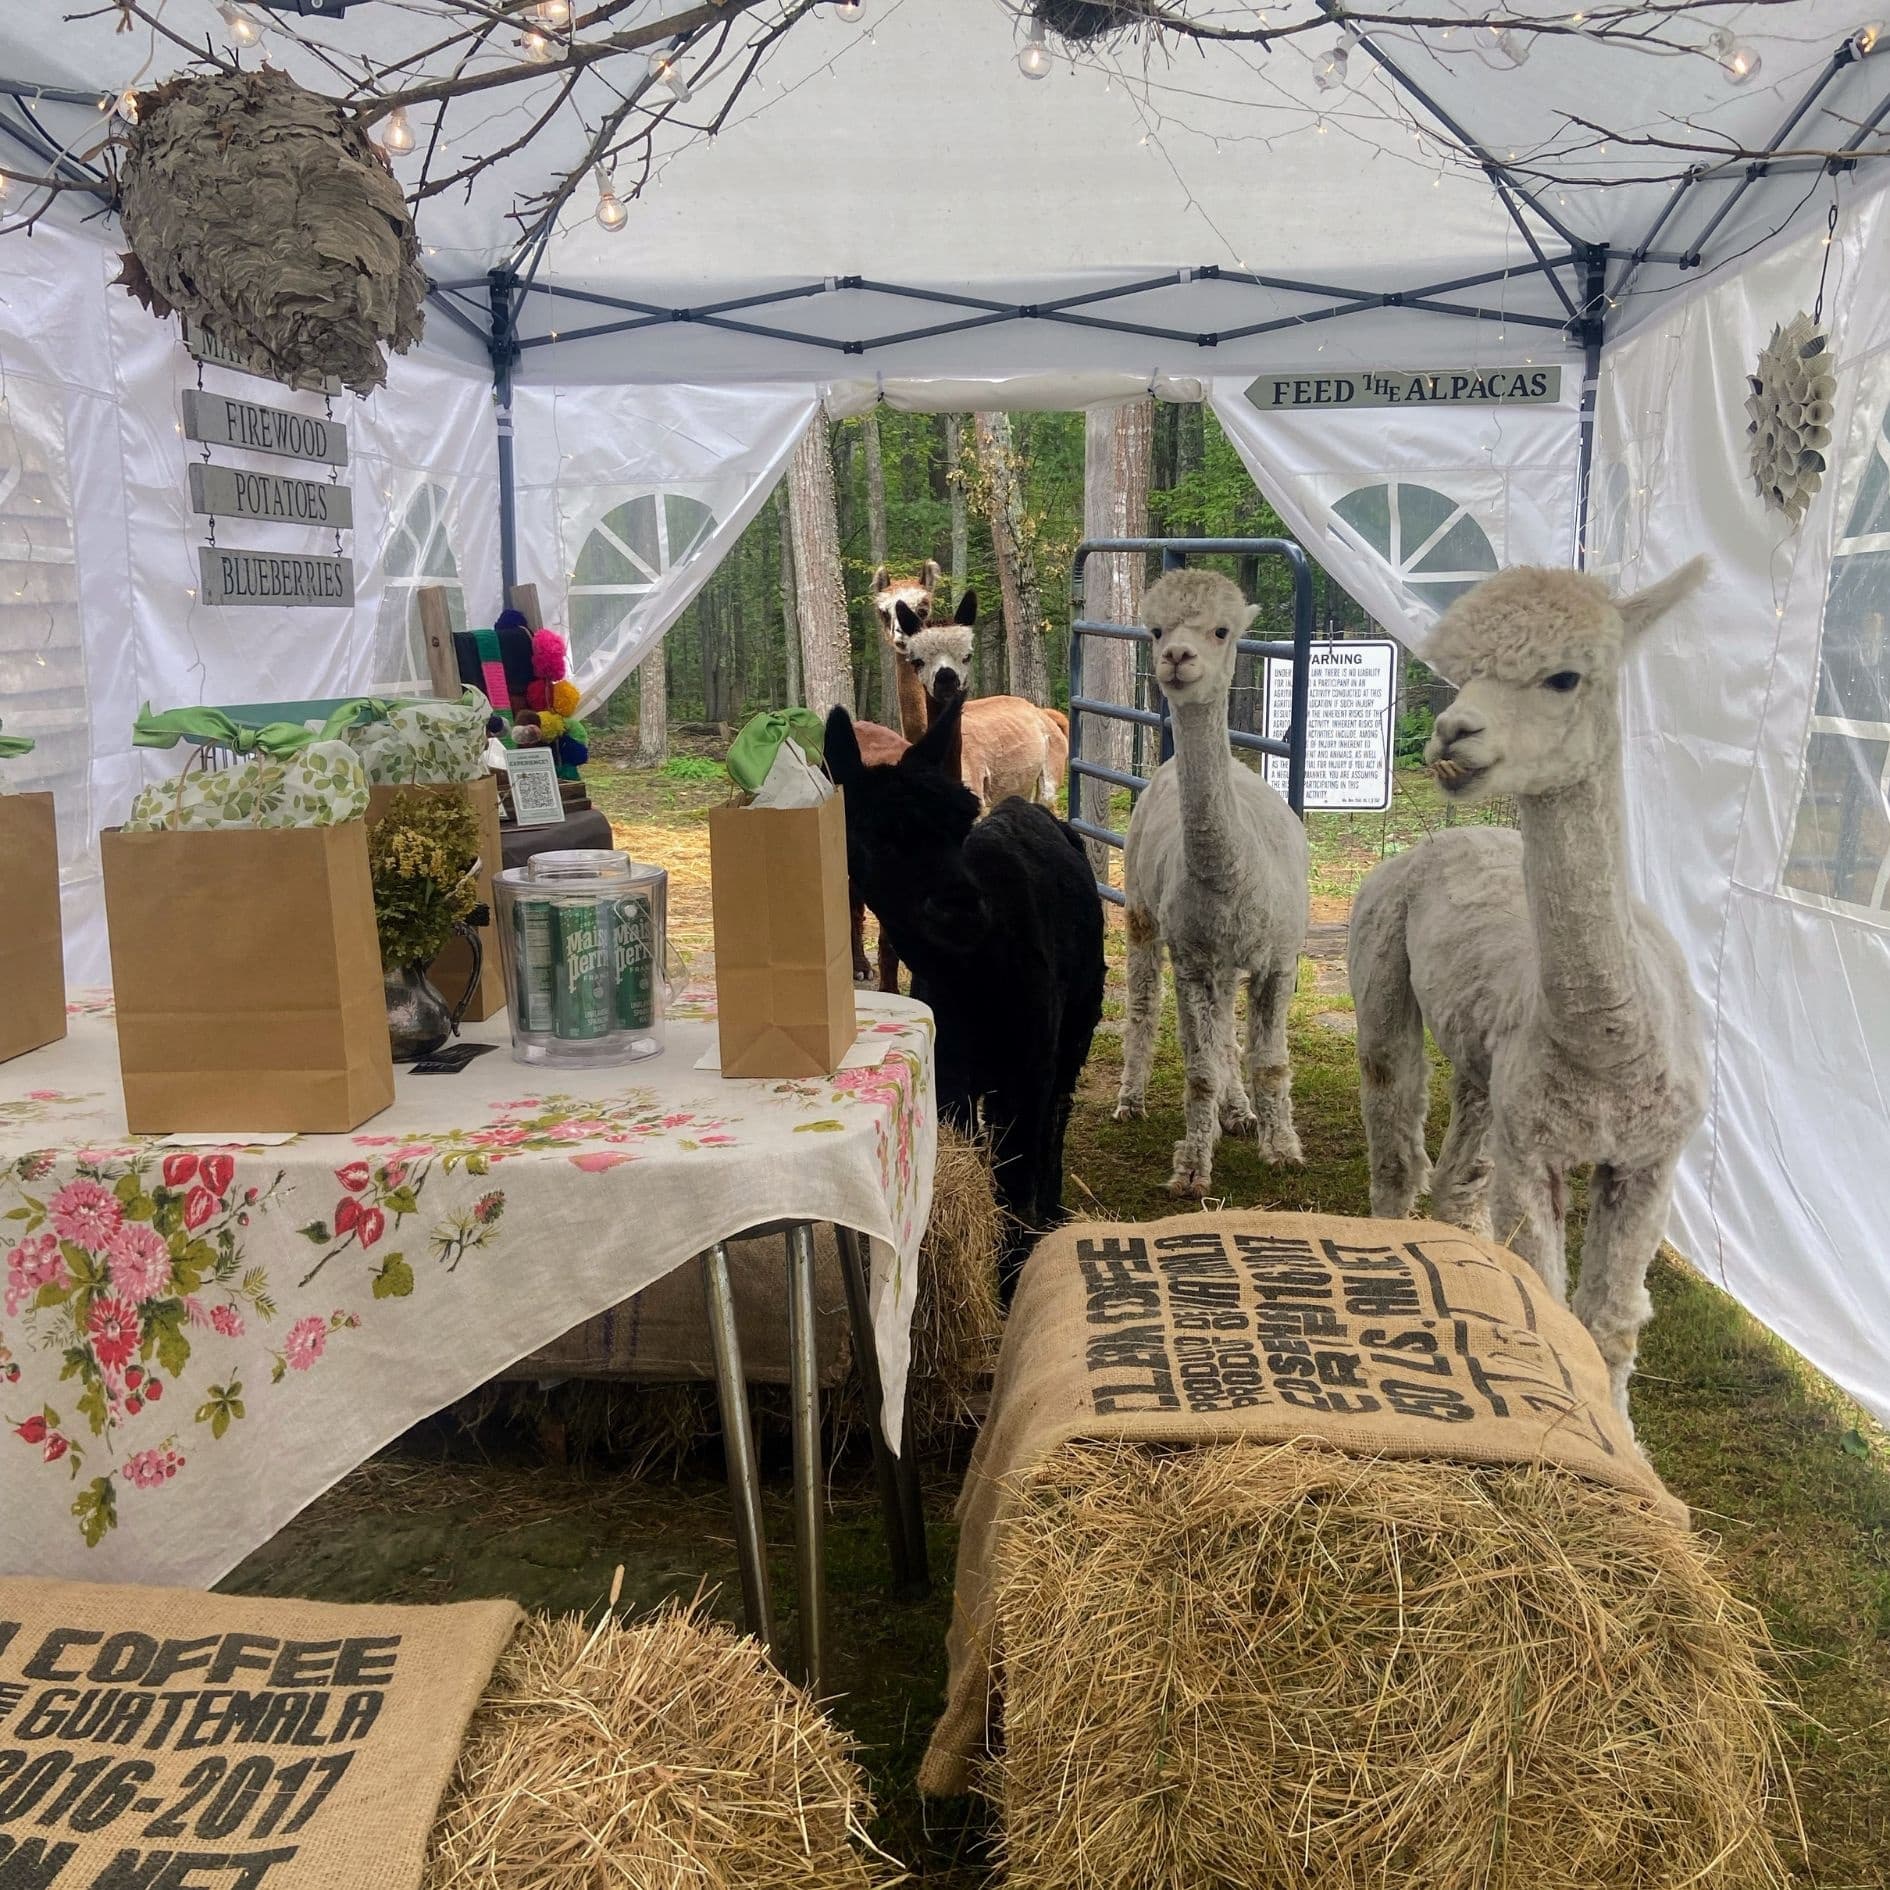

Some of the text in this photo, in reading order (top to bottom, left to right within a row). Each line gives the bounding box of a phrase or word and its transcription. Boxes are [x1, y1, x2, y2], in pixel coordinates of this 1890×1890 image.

[1272, 373, 1547, 405] FEED THE ALPACAS
[225, 401, 328, 458] FIREWOOD
[234, 472, 328, 521] POTATOES
[221, 556, 344, 598] BLUEBERRIES
[1309, 653, 1363, 665] ARNING
[1358, 1319, 1453, 1377] LS.
[22, 1627, 402, 1688] COFFEE
[13, 1687, 385, 1752] GUATEMALA
